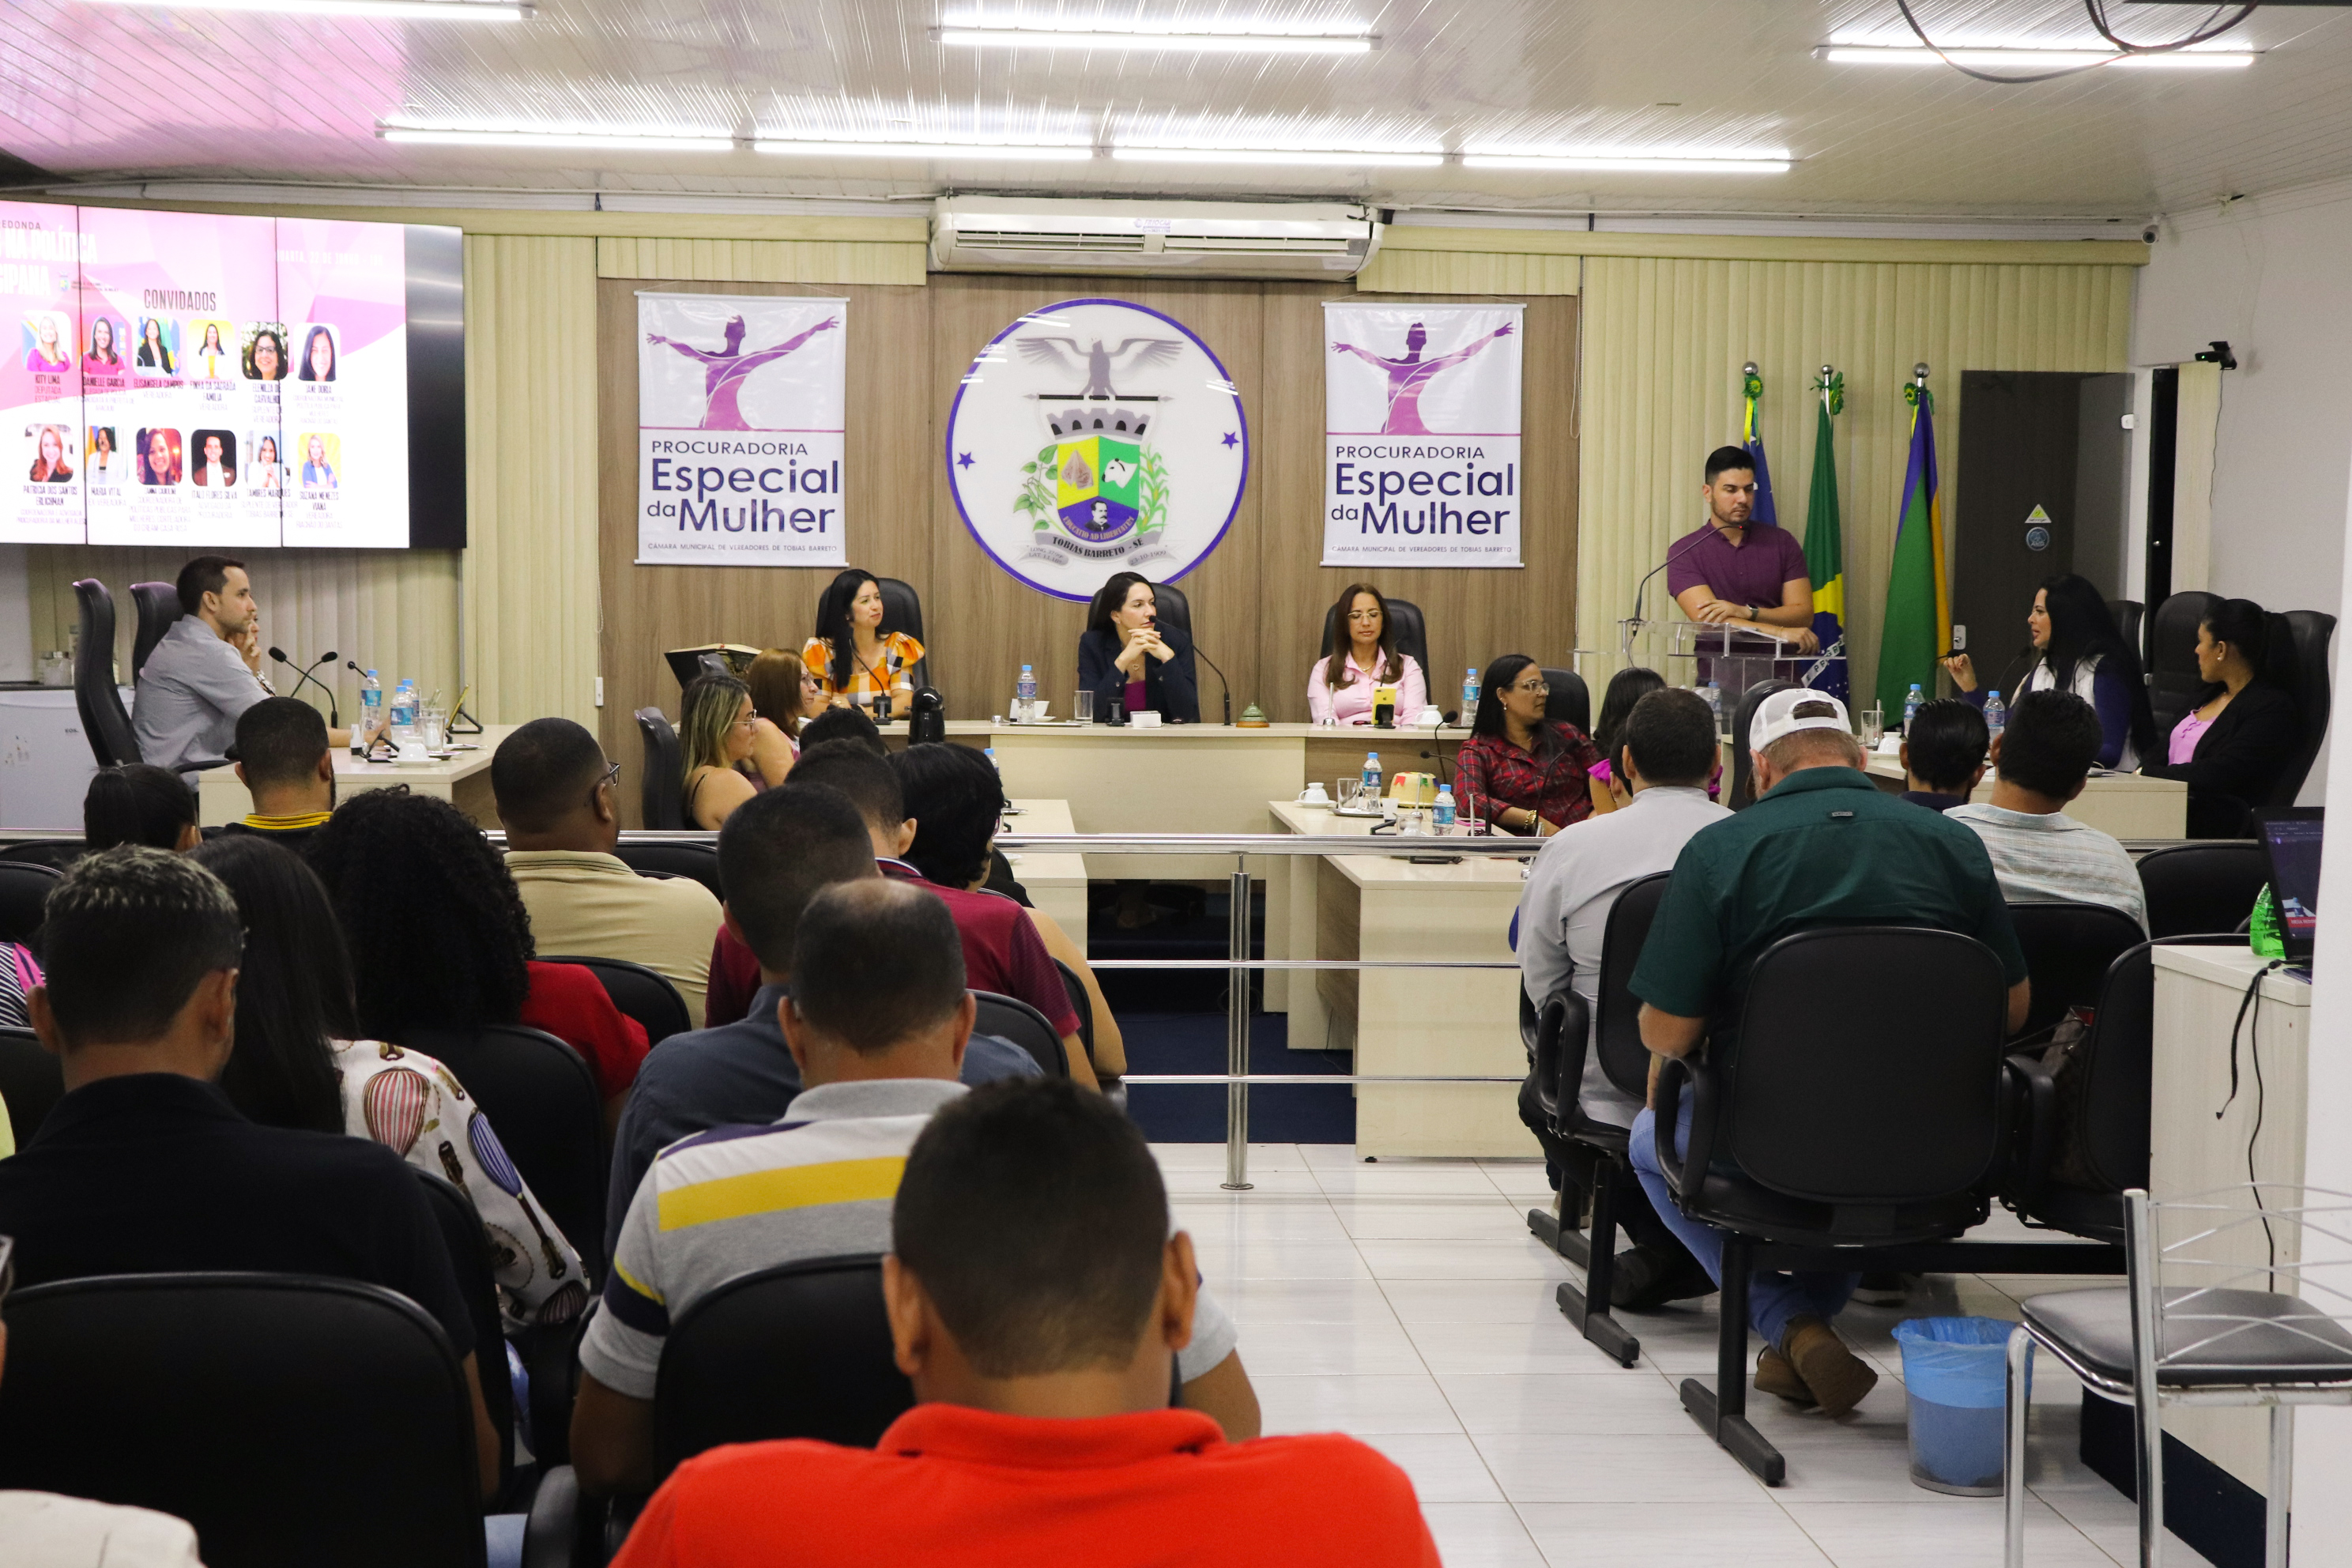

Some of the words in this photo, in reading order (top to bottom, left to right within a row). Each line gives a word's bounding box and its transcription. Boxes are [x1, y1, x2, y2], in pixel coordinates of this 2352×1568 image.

[0, 220, 41, 230] EDONDA
[5, 228, 28, 259] NA
[31, 224, 98, 264] POLÍTICA
[310, 251, 318, 263] 22
[322, 252, 332, 264] DE
[144, 289, 217, 311] CONVIDADOS
[47, 375, 60, 385] LIMA
[163, 379, 183, 389] CAMPOS
[205, 381, 213, 390] DA
[213, 381, 236, 391] SAGRADA
[652, 441, 808, 455] PROCURADORIA
[1336, 446, 1485, 458] PROCURADORIA
[652, 458, 838, 503] Especial
[1336, 462, 1513, 506] Especial
[47, 485, 57, 495] DOS
[58, 486, 77, 496] SANTOS
[91, 487, 107, 496] MARIA
[108, 487, 121, 496] VITAL
[205, 490, 223, 499] FLORES
[224, 491, 237, 499] SILVA
[647, 500, 675, 517] da
[678, 499, 835, 533] Mulher
[1331, 504, 1359, 520] da
[1361, 502, 1510, 534] Mulher
[1053, 537, 1083, 556] TOBIAS
[1084, 546, 1125, 558] BARRETO
[1133, 538, 1144, 548] SE
